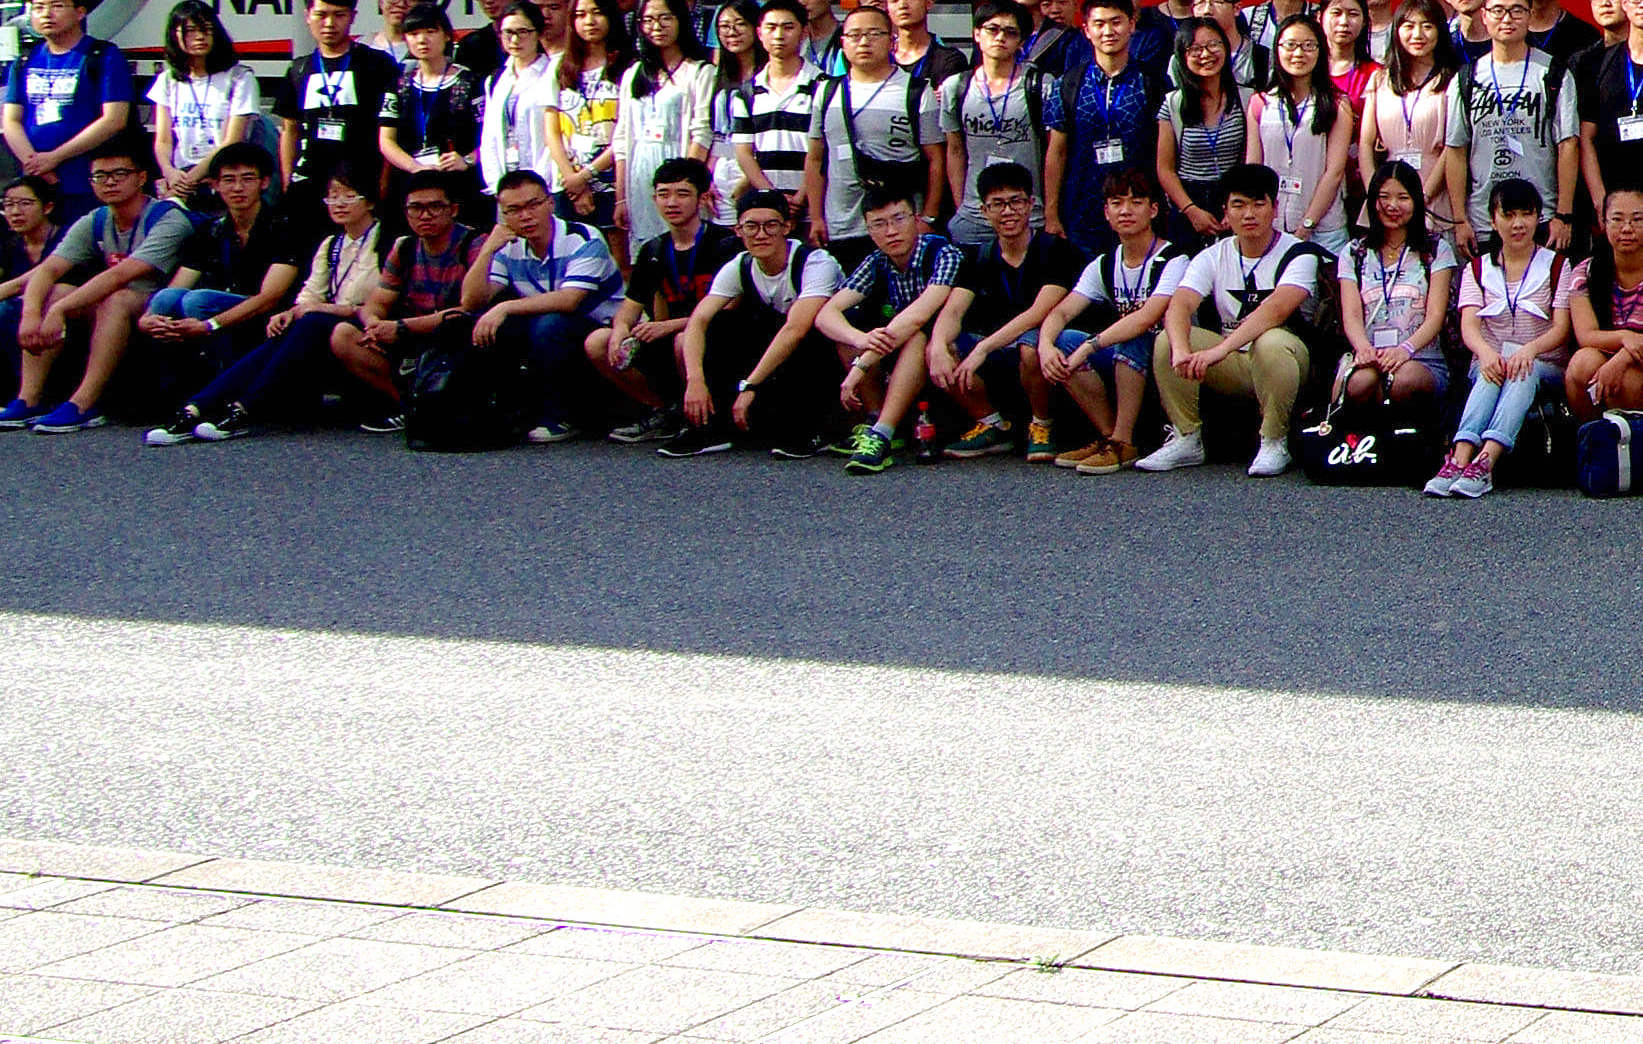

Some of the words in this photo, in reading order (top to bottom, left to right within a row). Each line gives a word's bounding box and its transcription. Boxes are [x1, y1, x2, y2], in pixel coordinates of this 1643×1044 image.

[180, 102, 212, 115] JUT
[171, 116, 224, 130] ERFECT
[1482, 120, 1499, 128] NEW
[1502, 118, 1525, 126] YORK
[889, 115, 912, 148] 076
